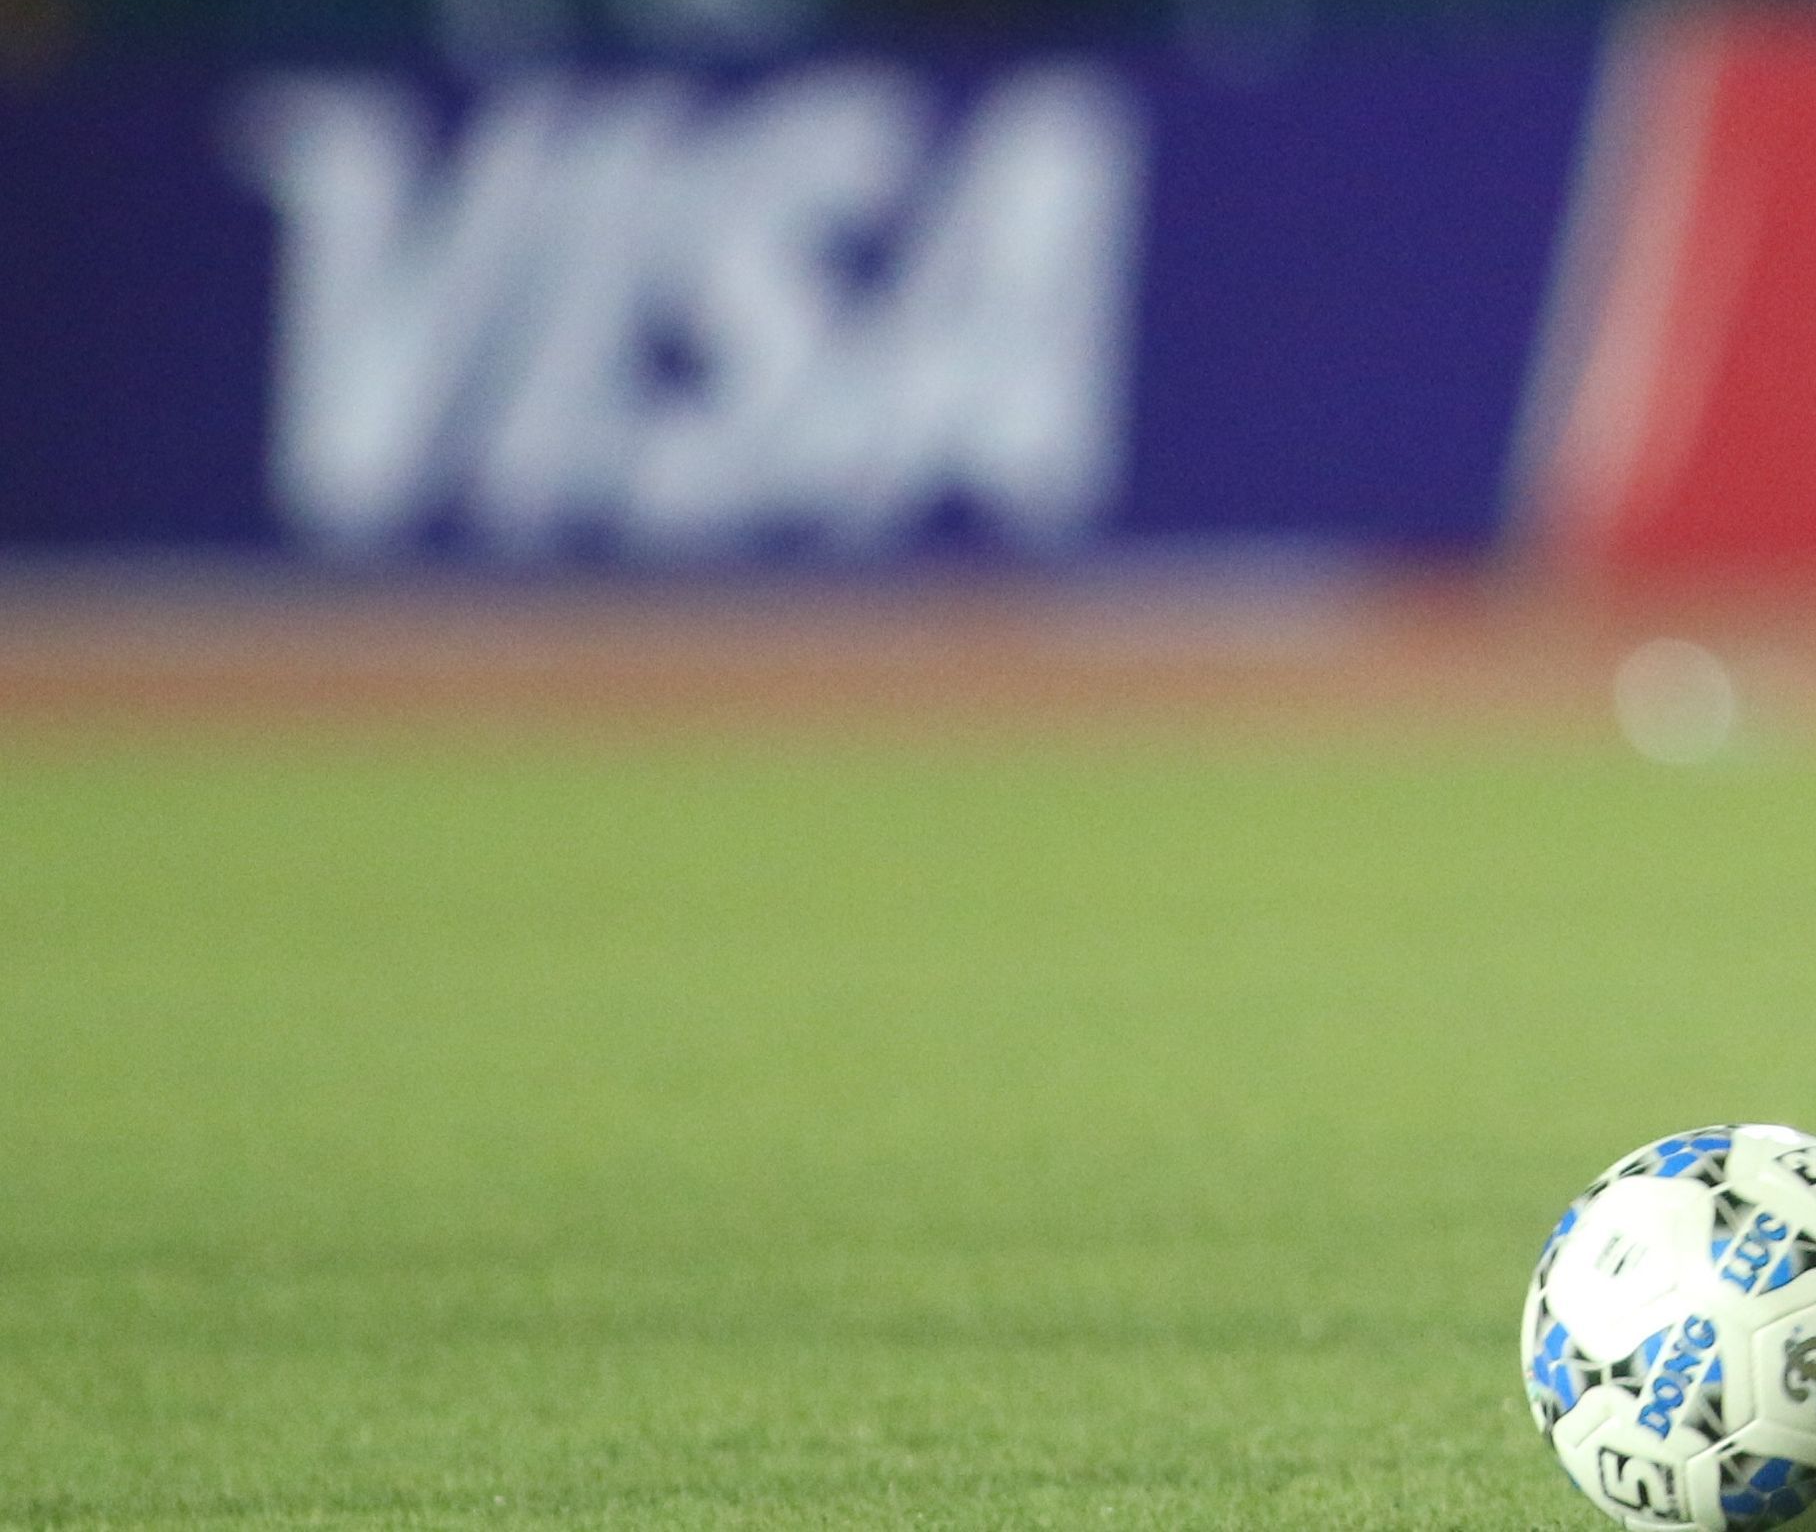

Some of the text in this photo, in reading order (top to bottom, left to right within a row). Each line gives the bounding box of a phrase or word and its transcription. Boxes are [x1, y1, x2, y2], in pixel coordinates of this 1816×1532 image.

[235, 63, 1142, 558] VISA
[1637, 1211, 1788, 1442] DONG LUC
